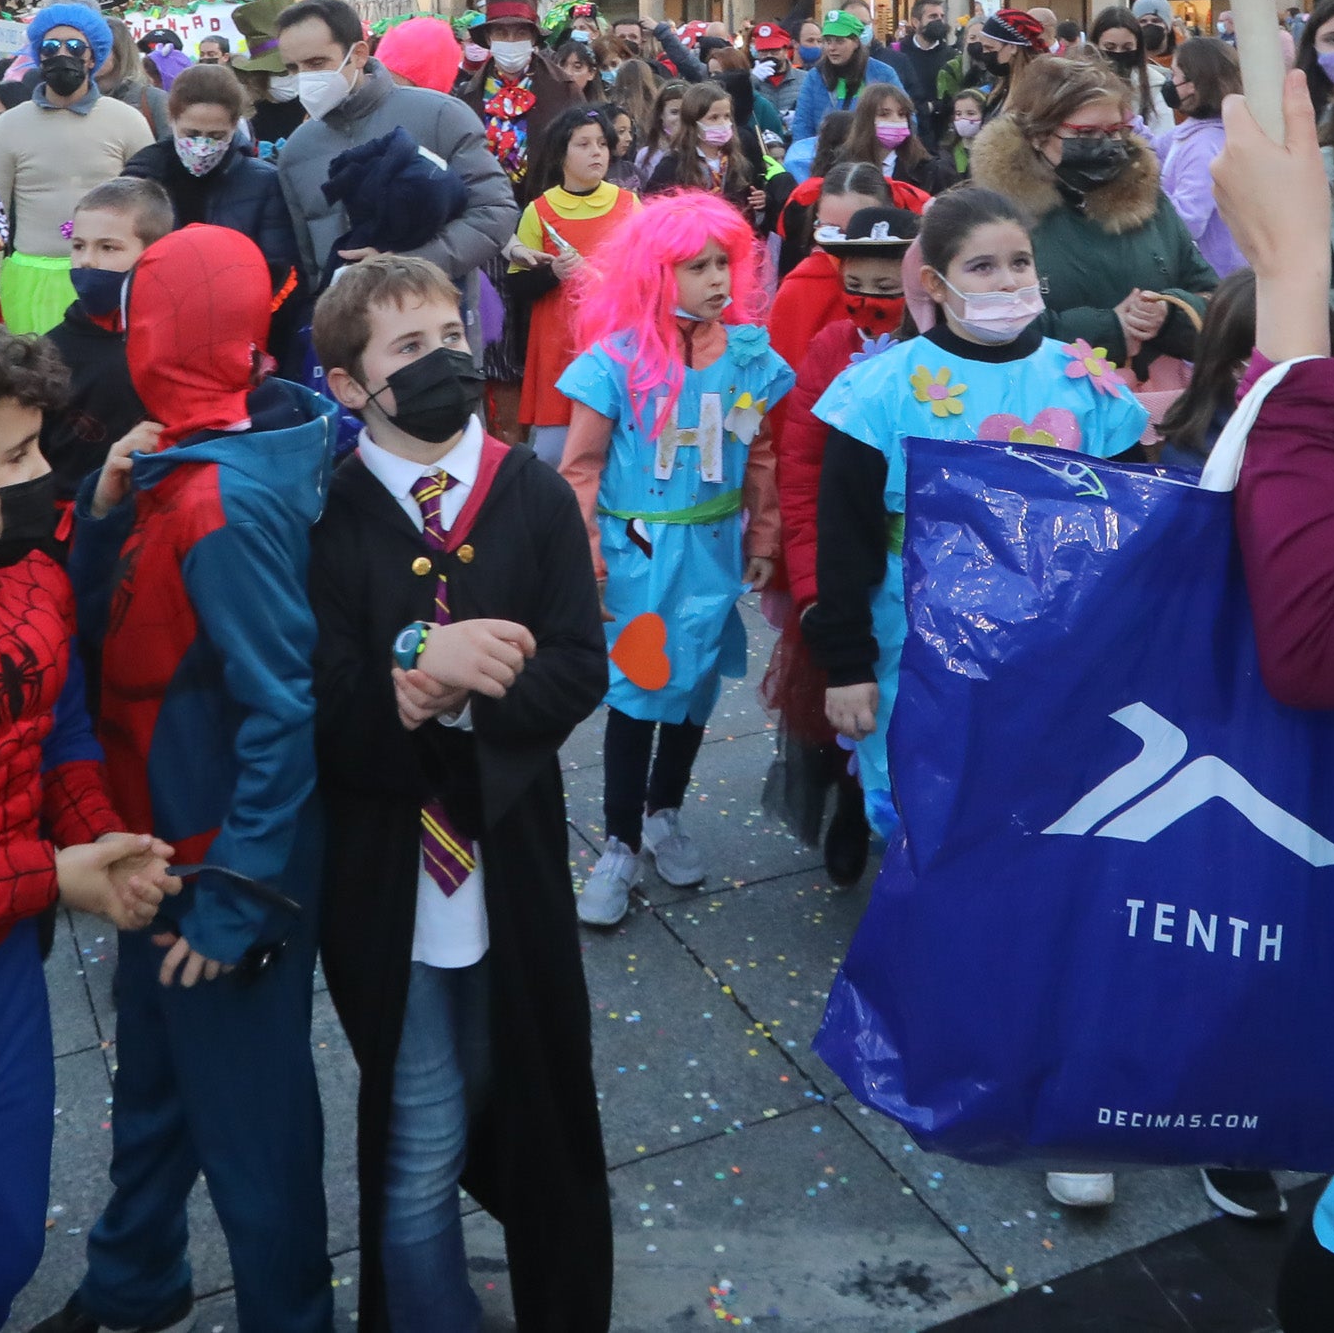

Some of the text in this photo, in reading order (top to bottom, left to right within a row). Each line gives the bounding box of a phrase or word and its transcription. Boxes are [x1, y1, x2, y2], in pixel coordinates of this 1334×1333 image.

[654, 392, 724, 484] H
[1126, 898, 1283, 962] TENTH
[1097, 1107, 1259, 1130] DECIMAS.COM
